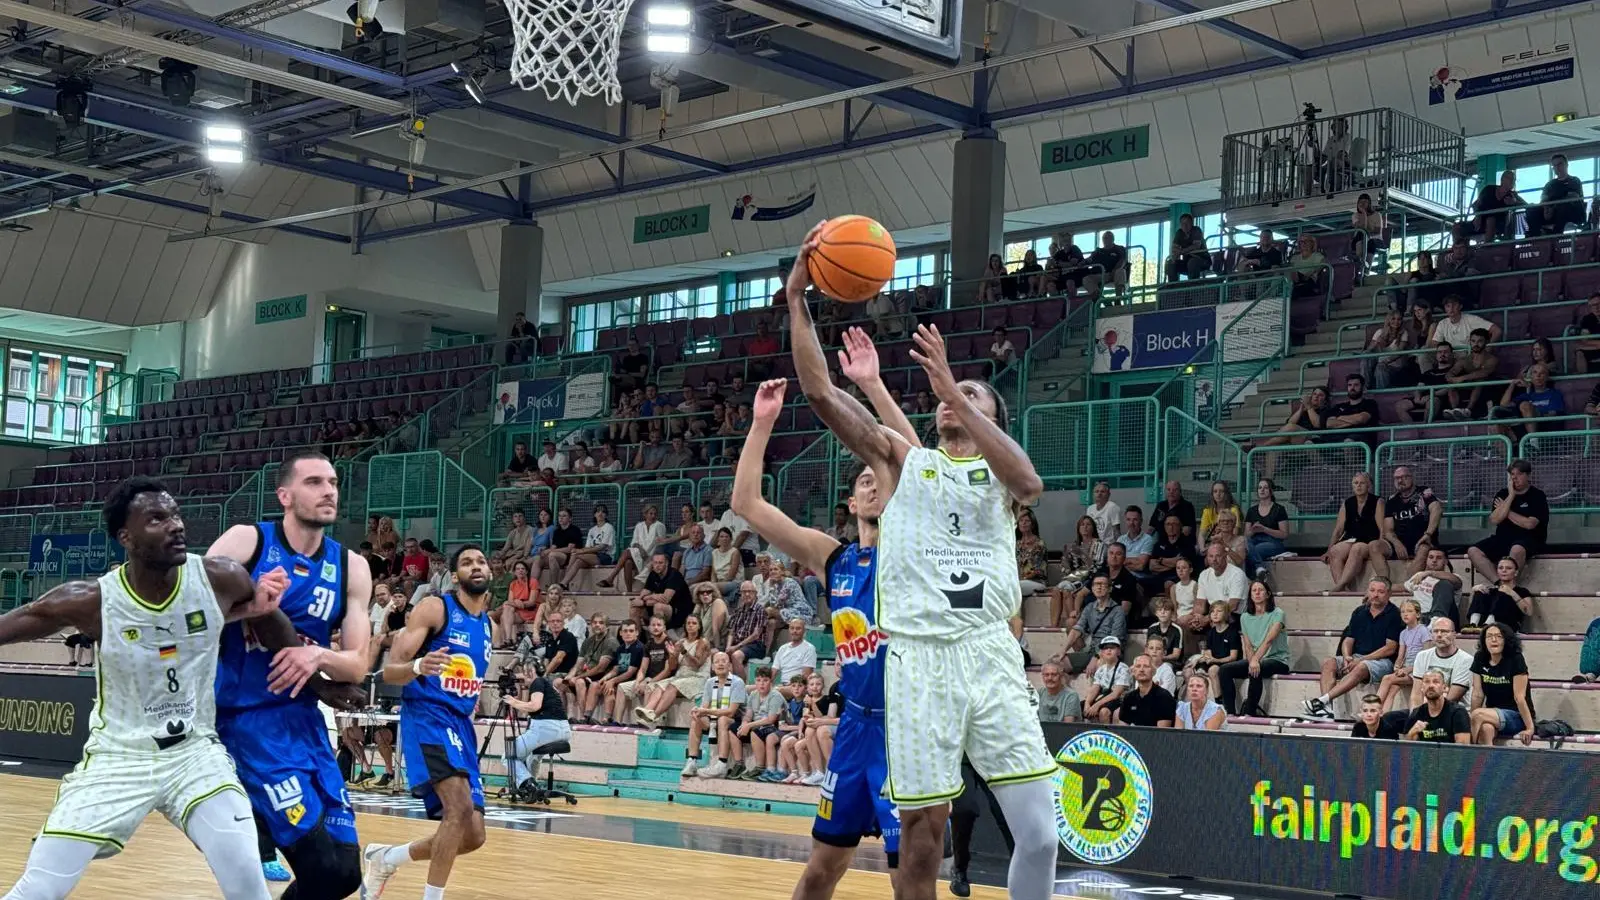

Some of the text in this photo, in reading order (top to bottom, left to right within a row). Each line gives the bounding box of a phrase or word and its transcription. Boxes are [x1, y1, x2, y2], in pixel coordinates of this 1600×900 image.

[1052, 134, 1136, 165] BLOCK H
[644, 213, 698, 236] BLOCK J
[260, 300, 302, 318] BLOCK K
[1146, 328, 1209, 351] Block H
[555, 394, 560, 407] J
[948, 512, 961, 536] 3
[938, 557, 980, 567] per Klick
[307, 586, 336, 621] 31
[167, 667, 179, 693] 8
[158, 709, 172, 719] per
[1069, 736, 1132, 759] BBC BAYREUTH
